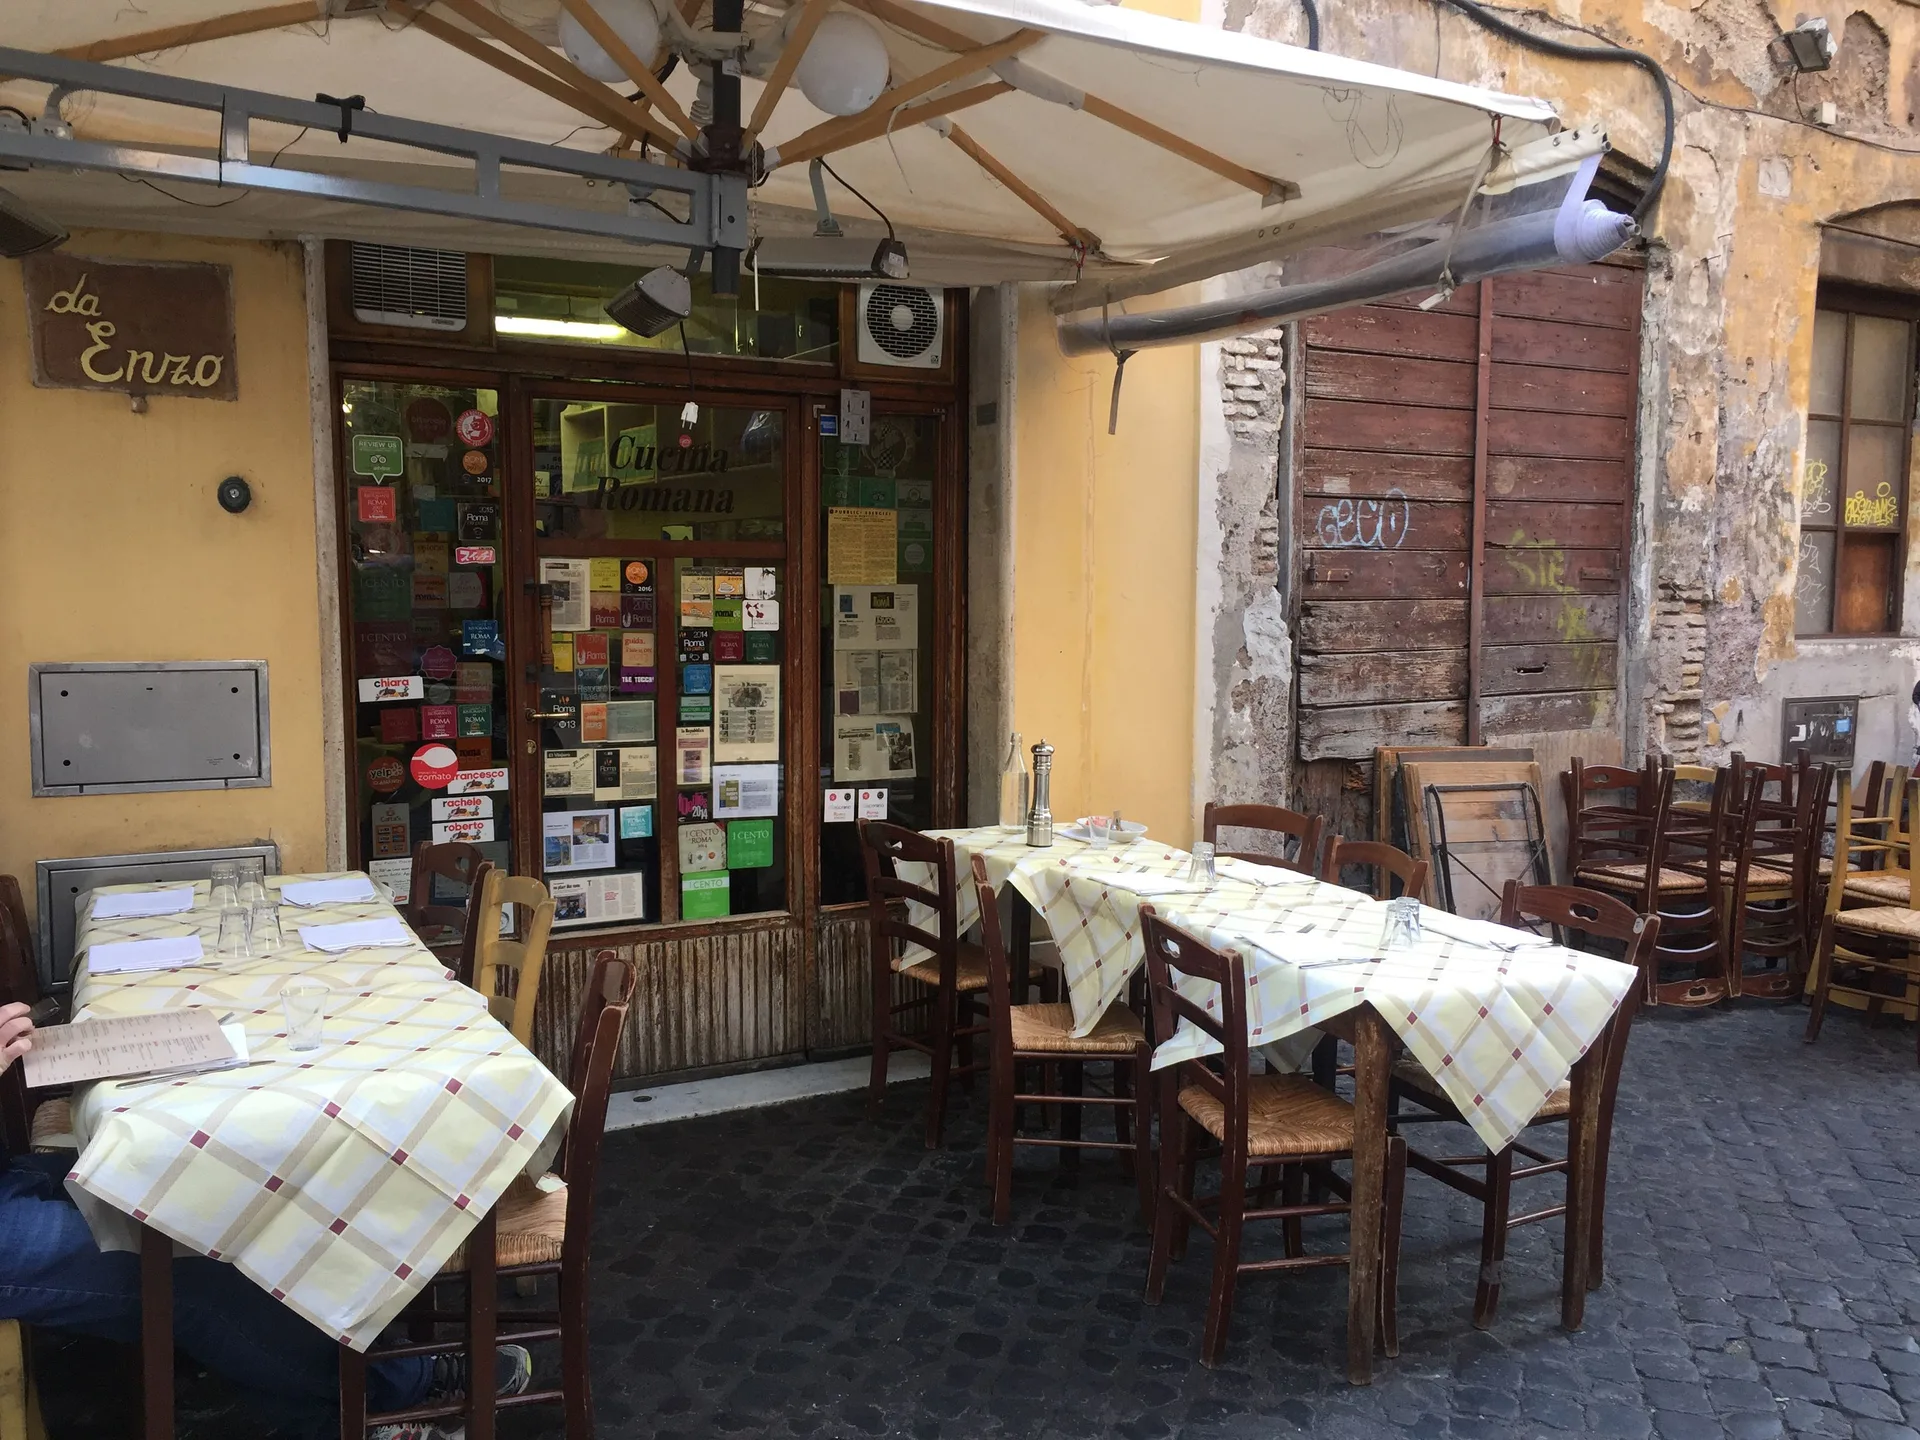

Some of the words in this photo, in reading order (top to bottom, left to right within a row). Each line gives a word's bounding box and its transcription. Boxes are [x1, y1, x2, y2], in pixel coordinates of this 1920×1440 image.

[45, 273, 101, 316] da
[80, 321, 224, 387] Enzo
[609, 434, 729, 474] Cucina
[476, 476, 492, 484] 2017
[594, 476, 735, 514] Romana
[466, 513, 489, 522] Roma
[366, 578, 405, 588] CENTO
[595, 614, 616, 624] Roma
[632, 613, 653, 623] Roma
[367, 633, 407, 642] CENTO
[683, 639, 705, 647] Roma
[586, 651, 606, 660] Roma
[373, 678, 409, 687] chiara
[553, 705, 576, 713] Roma
[371, 768, 392, 779] yelp
[418, 773, 452, 781] zomato
[455, 770, 505, 780] rancesco
[443, 796, 482, 808] rachele
[444, 821, 484, 832] roberto
[689, 828, 720, 838] CENTO
[737, 829, 769, 840] CENTO
[691, 836, 713, 844] ROMA
[693, 879, 723, 889] CENTO
